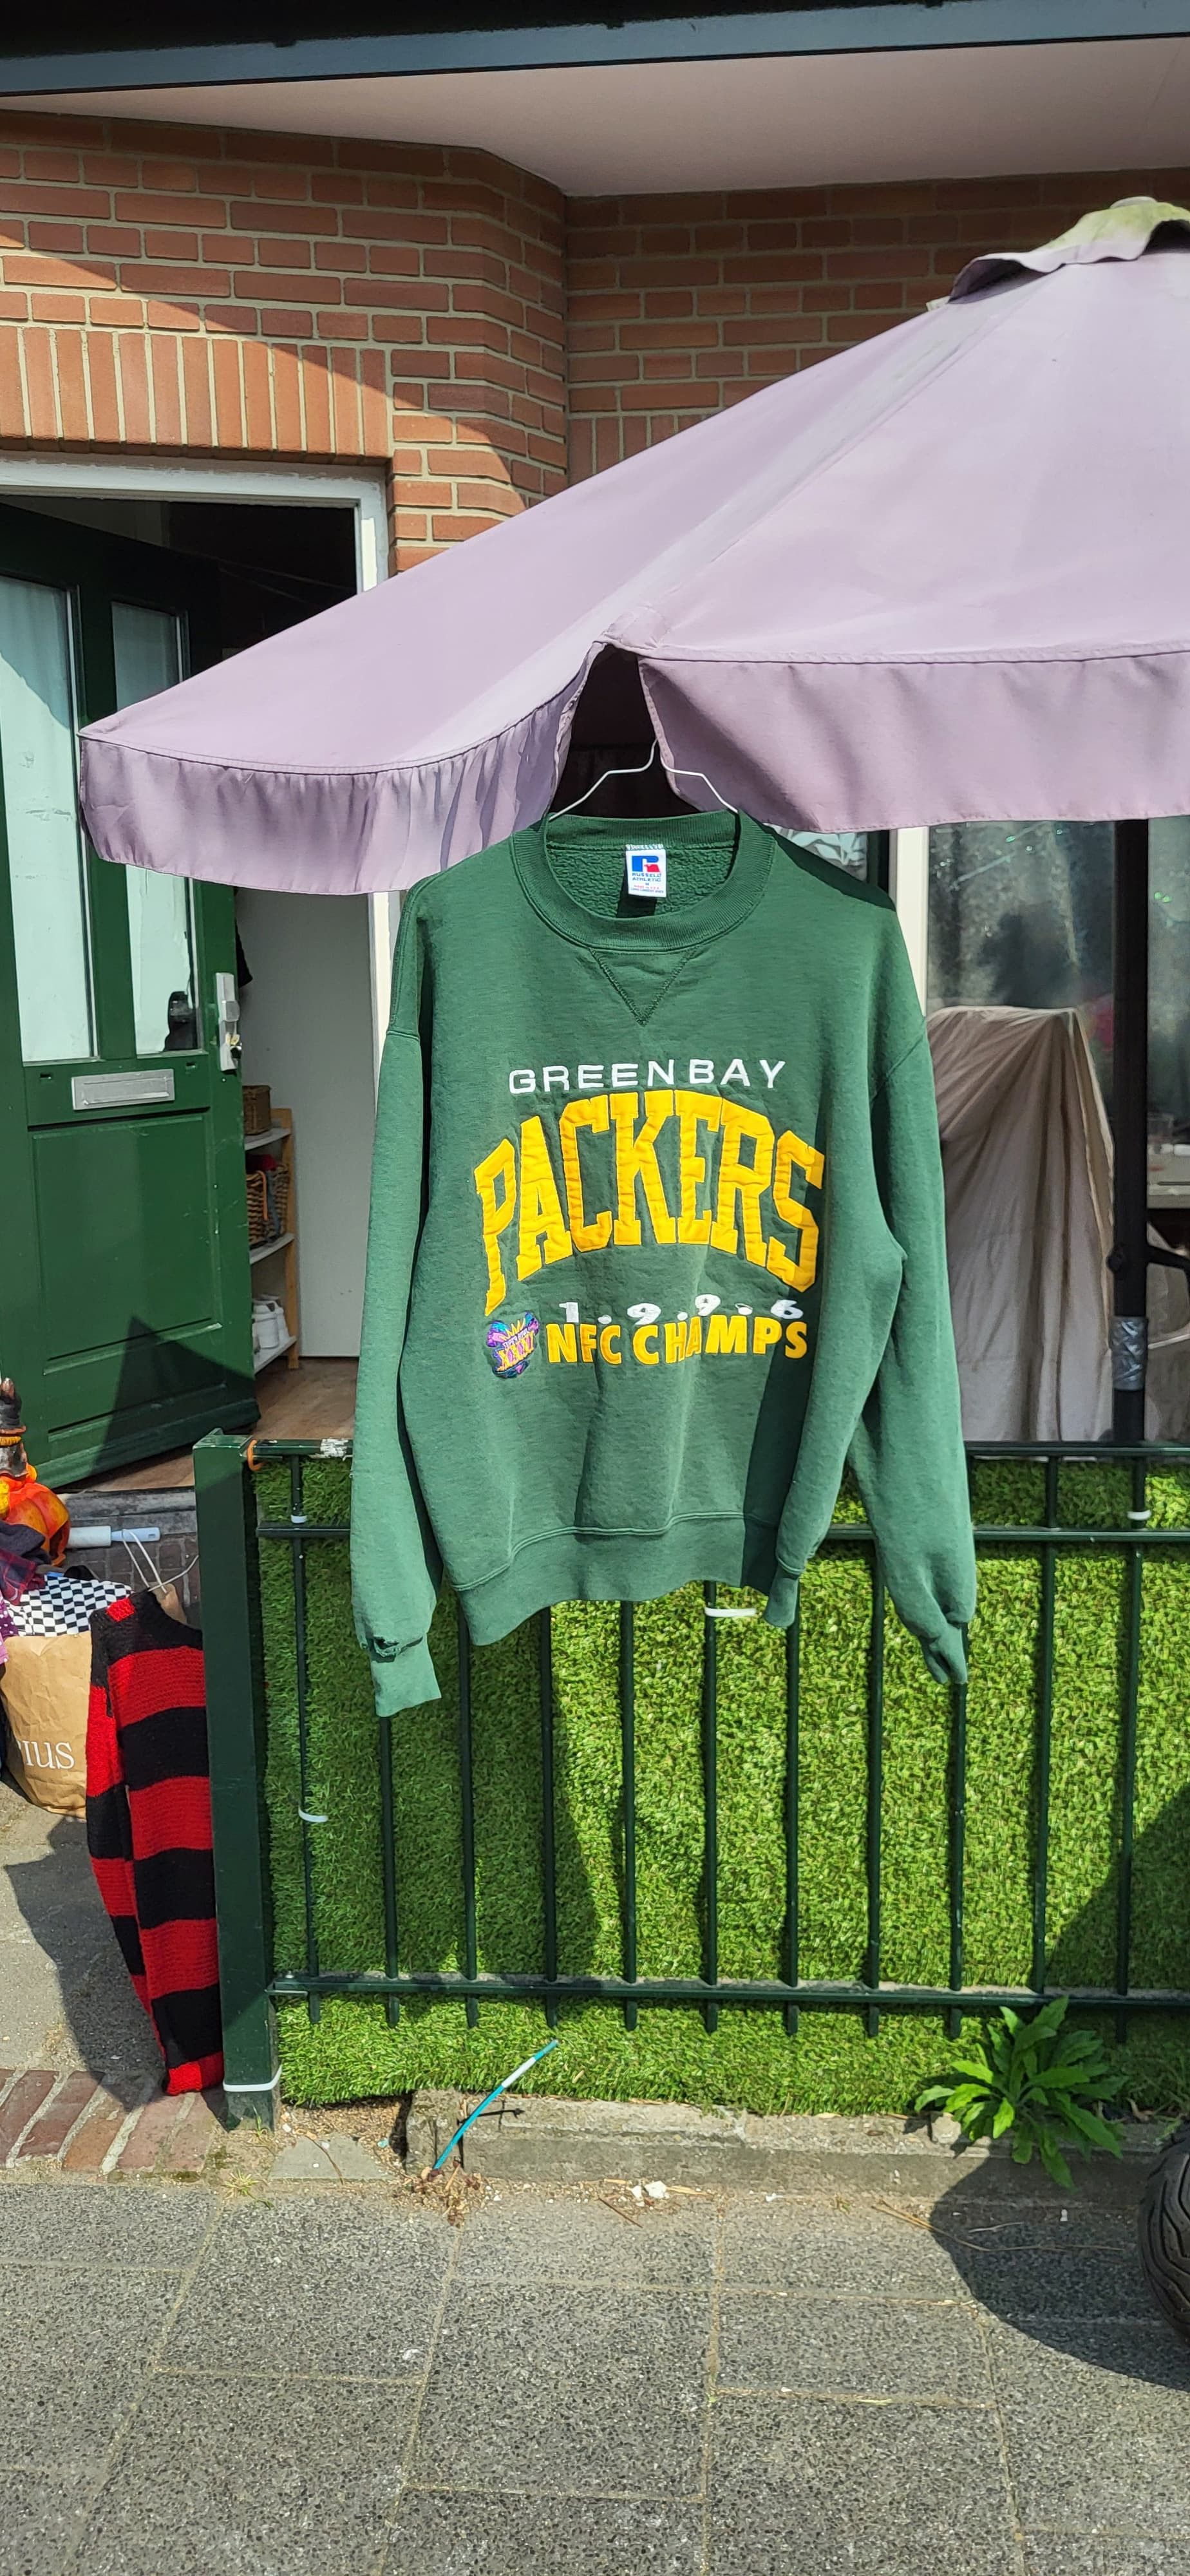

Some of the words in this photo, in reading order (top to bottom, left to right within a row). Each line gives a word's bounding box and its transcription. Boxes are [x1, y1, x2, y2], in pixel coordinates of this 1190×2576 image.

[474, 1090, 825, 1316] PACKERS
[545, 1323, 623, 1365] NFC
[632, 1314, 808, 1365] CHAMPS
